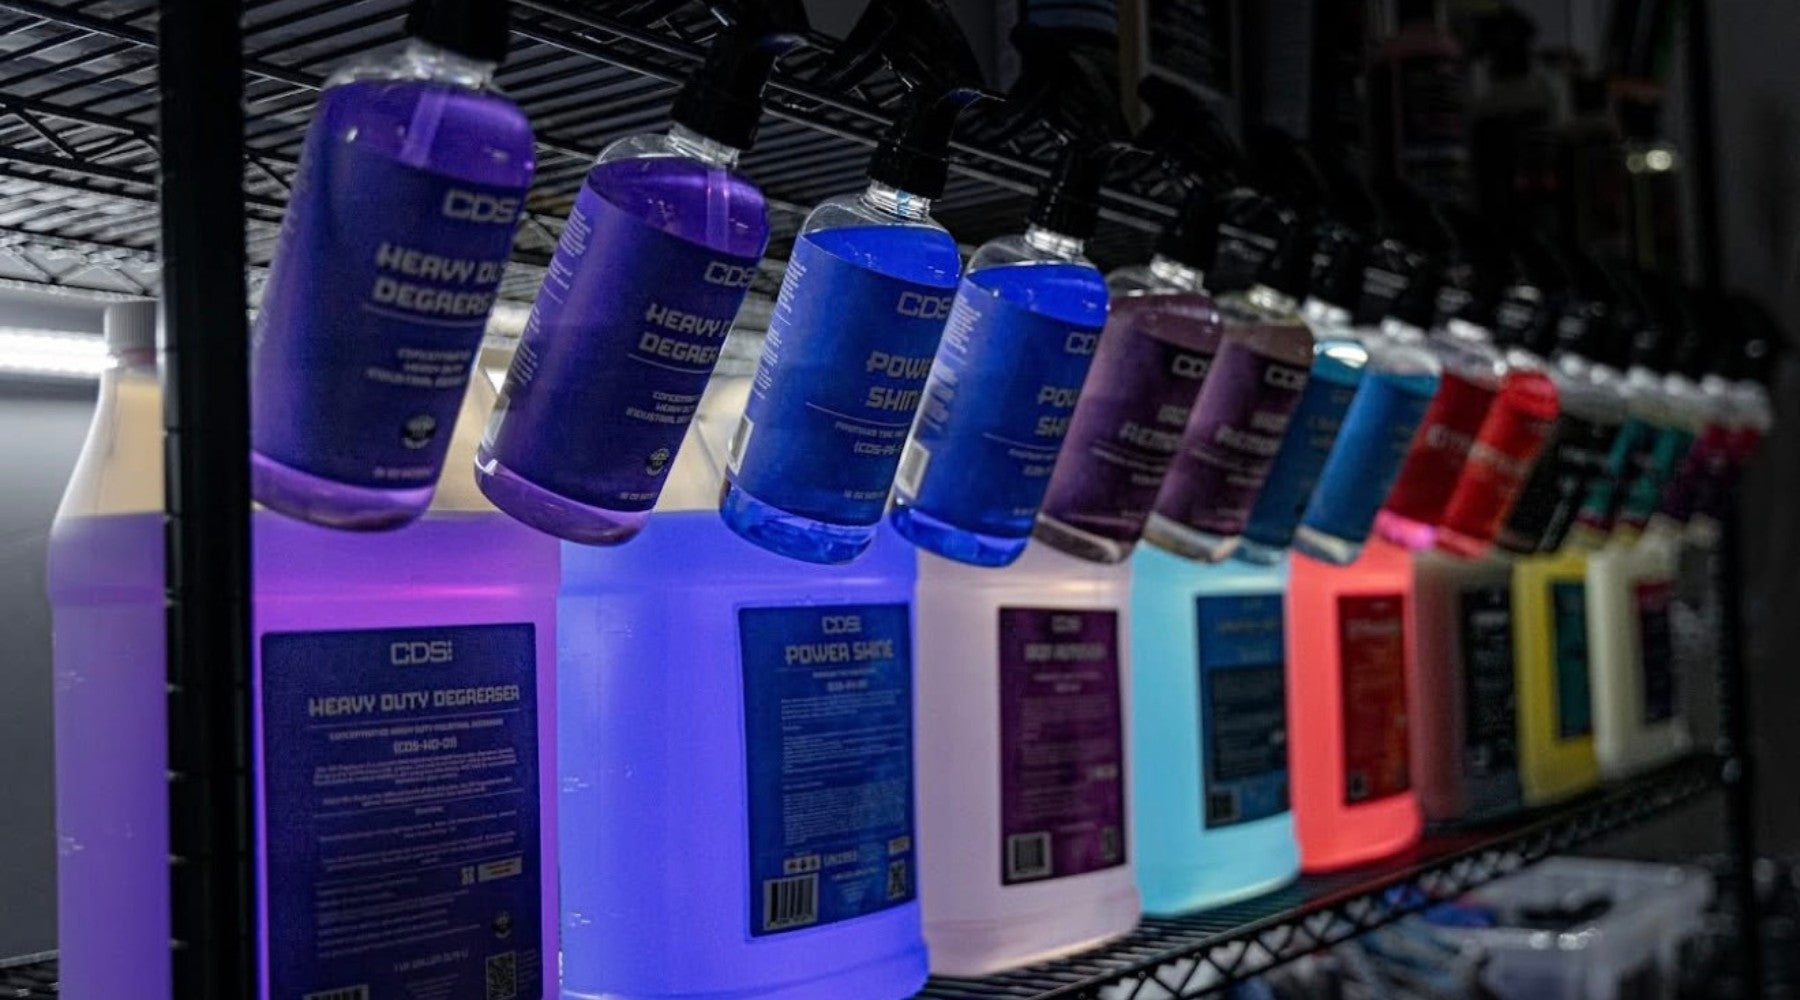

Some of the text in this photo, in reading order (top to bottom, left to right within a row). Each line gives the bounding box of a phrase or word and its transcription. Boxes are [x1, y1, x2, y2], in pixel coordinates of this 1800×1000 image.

[443, 189, 517, 224] CDS
[376, 242, 477, 284] HEAVY
[645, 302, 721, 338] HEAVY
[785, 642, 850, 666] POWER
[309, 685, 520, 717] HEAVY DUTY DEGREASER
